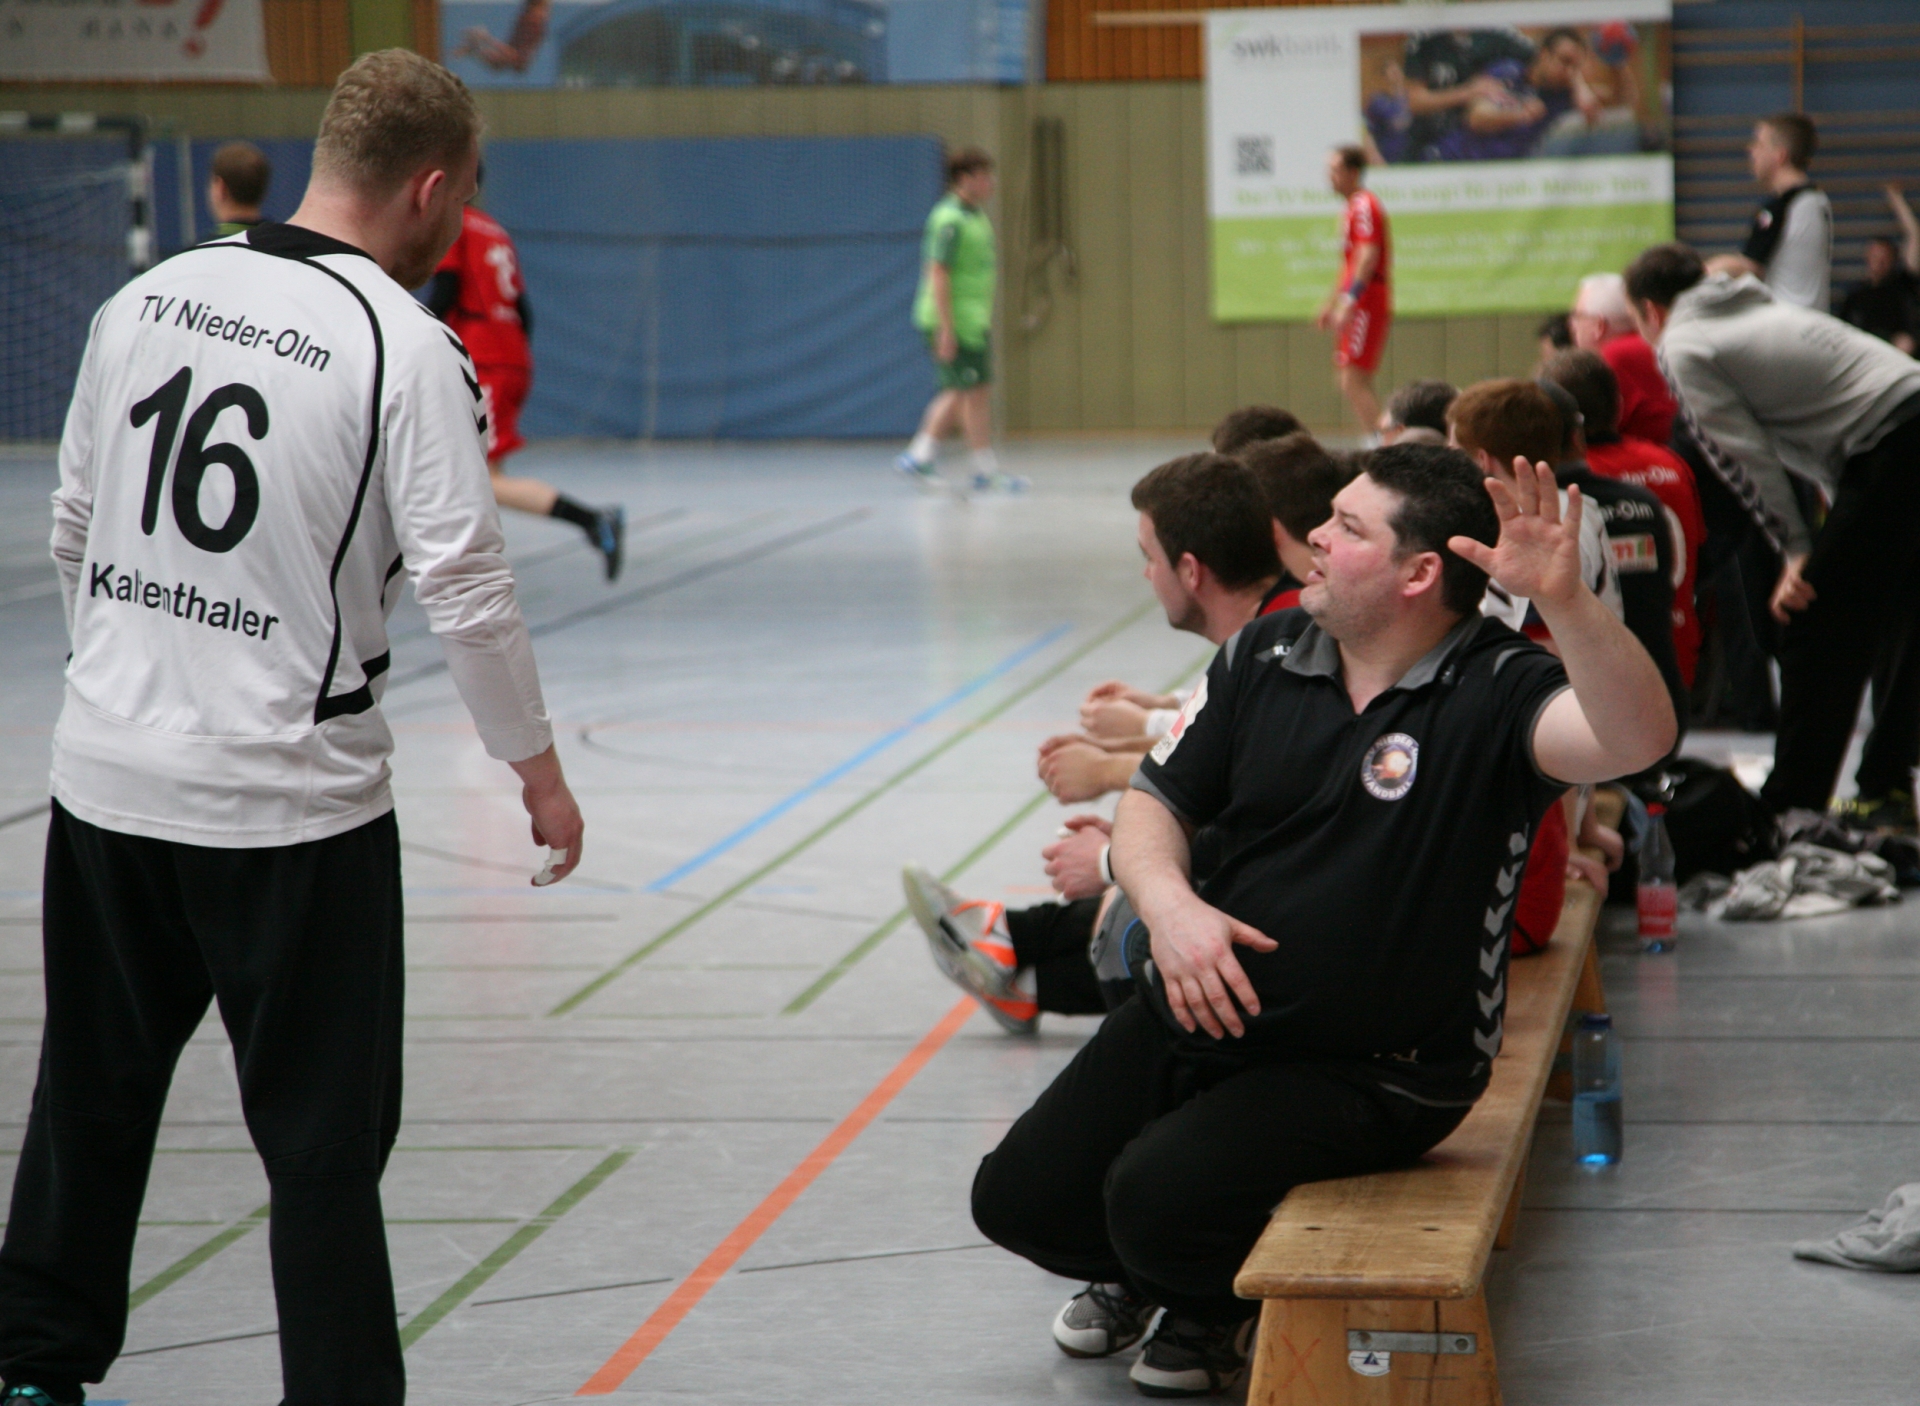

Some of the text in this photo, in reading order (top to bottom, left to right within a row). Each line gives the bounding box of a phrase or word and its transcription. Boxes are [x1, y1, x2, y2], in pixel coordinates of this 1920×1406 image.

[139, 295, 332, 372] TV Nieder-Olm
[129, 365, 270, 554] 16
